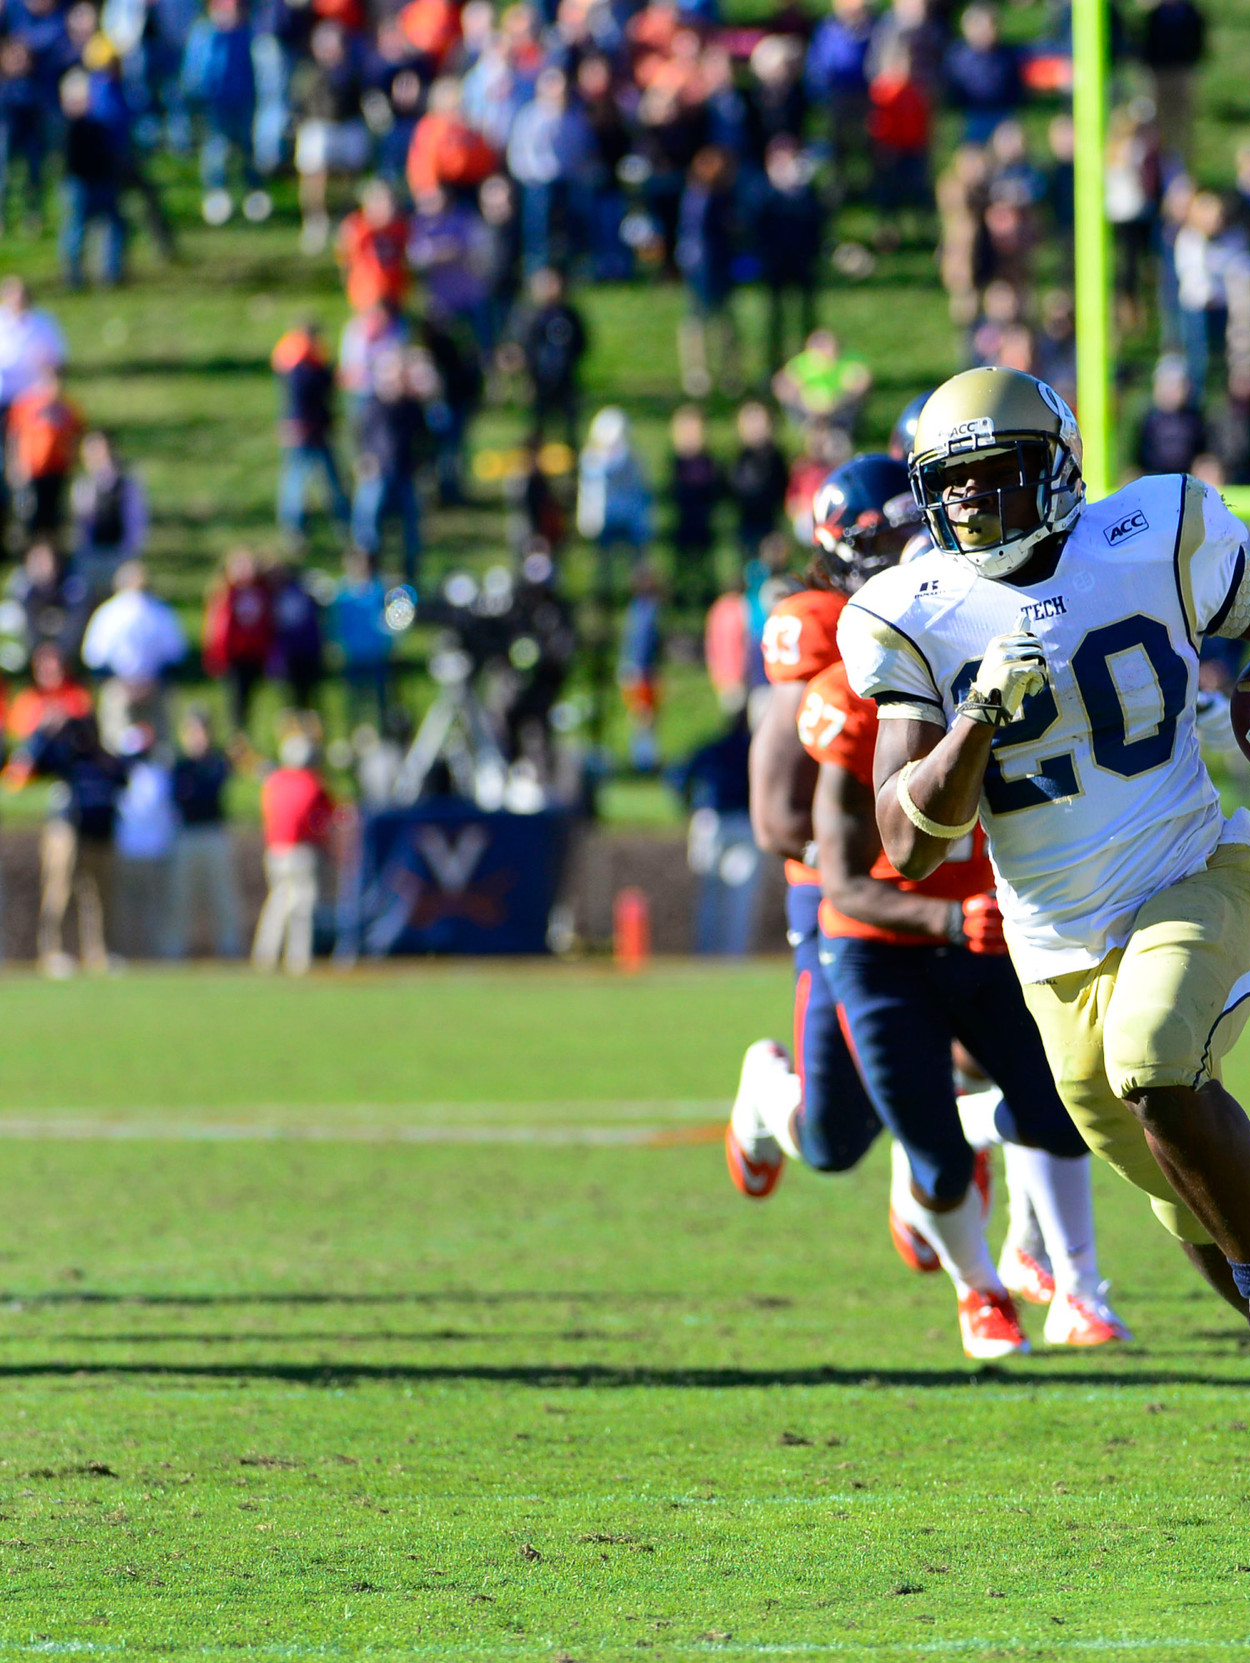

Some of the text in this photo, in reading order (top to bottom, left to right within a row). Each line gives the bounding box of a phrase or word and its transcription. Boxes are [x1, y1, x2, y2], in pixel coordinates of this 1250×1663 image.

[950, 421, 976, 438] ACC
[1109, 513, 1144, 542] ACC
[1020, 595, 1067, 621] TECH
[797, 691, 848, 749] 27
[949, 610, 1190, 819] 20
